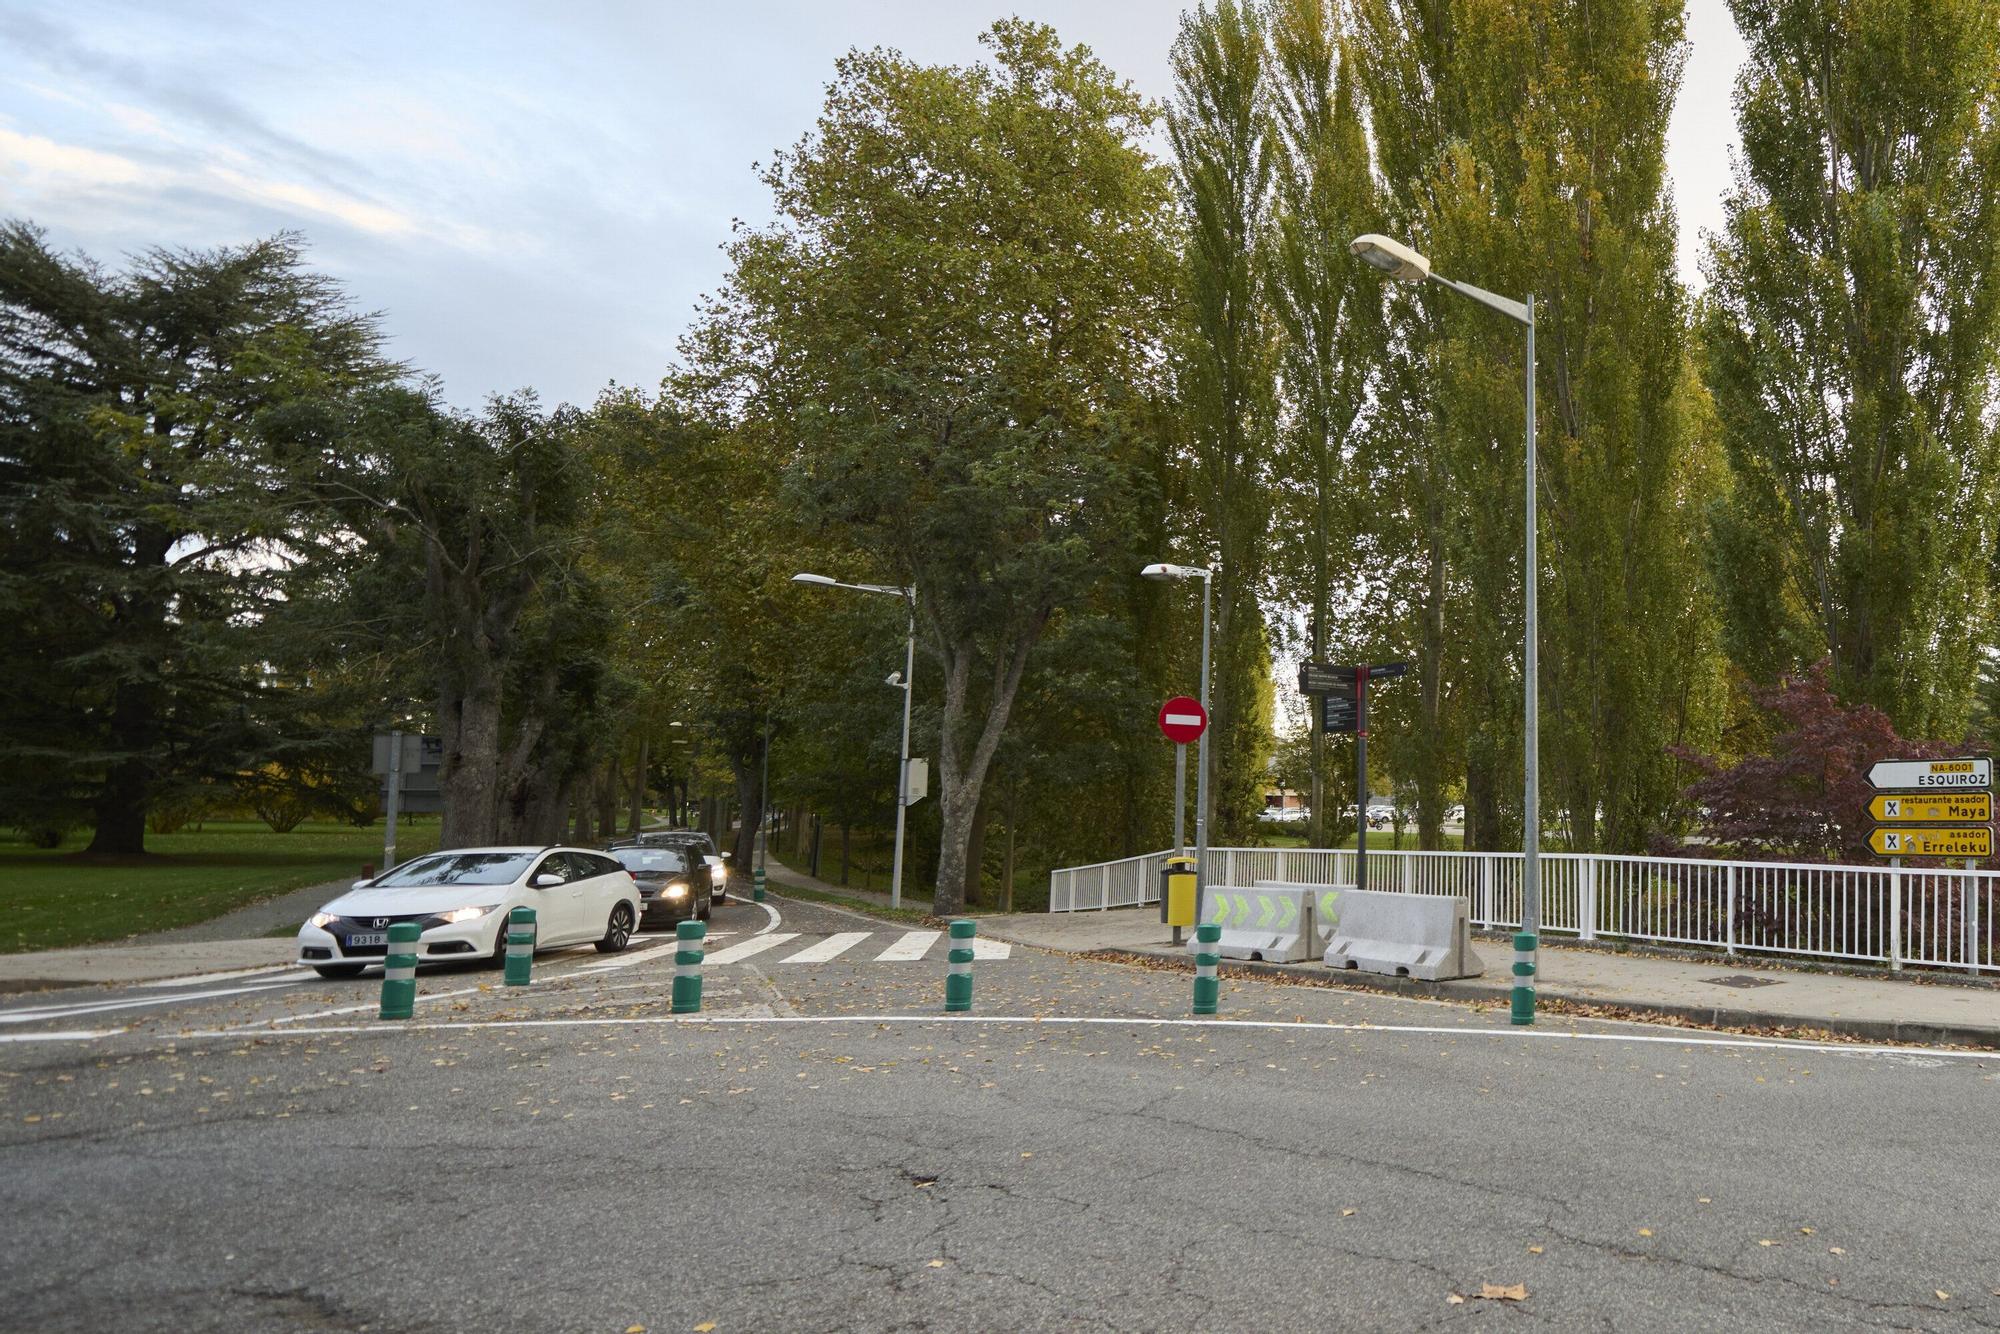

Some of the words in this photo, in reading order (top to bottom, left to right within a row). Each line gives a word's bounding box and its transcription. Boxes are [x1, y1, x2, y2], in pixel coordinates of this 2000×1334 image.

[1918, 774, 1986, 785] ESQUIROZ
[1948, 806, 1986, 818] Maya
[1923, 842, 1986, 852] Erreleku
[354, 936, 380, 944] 9318
